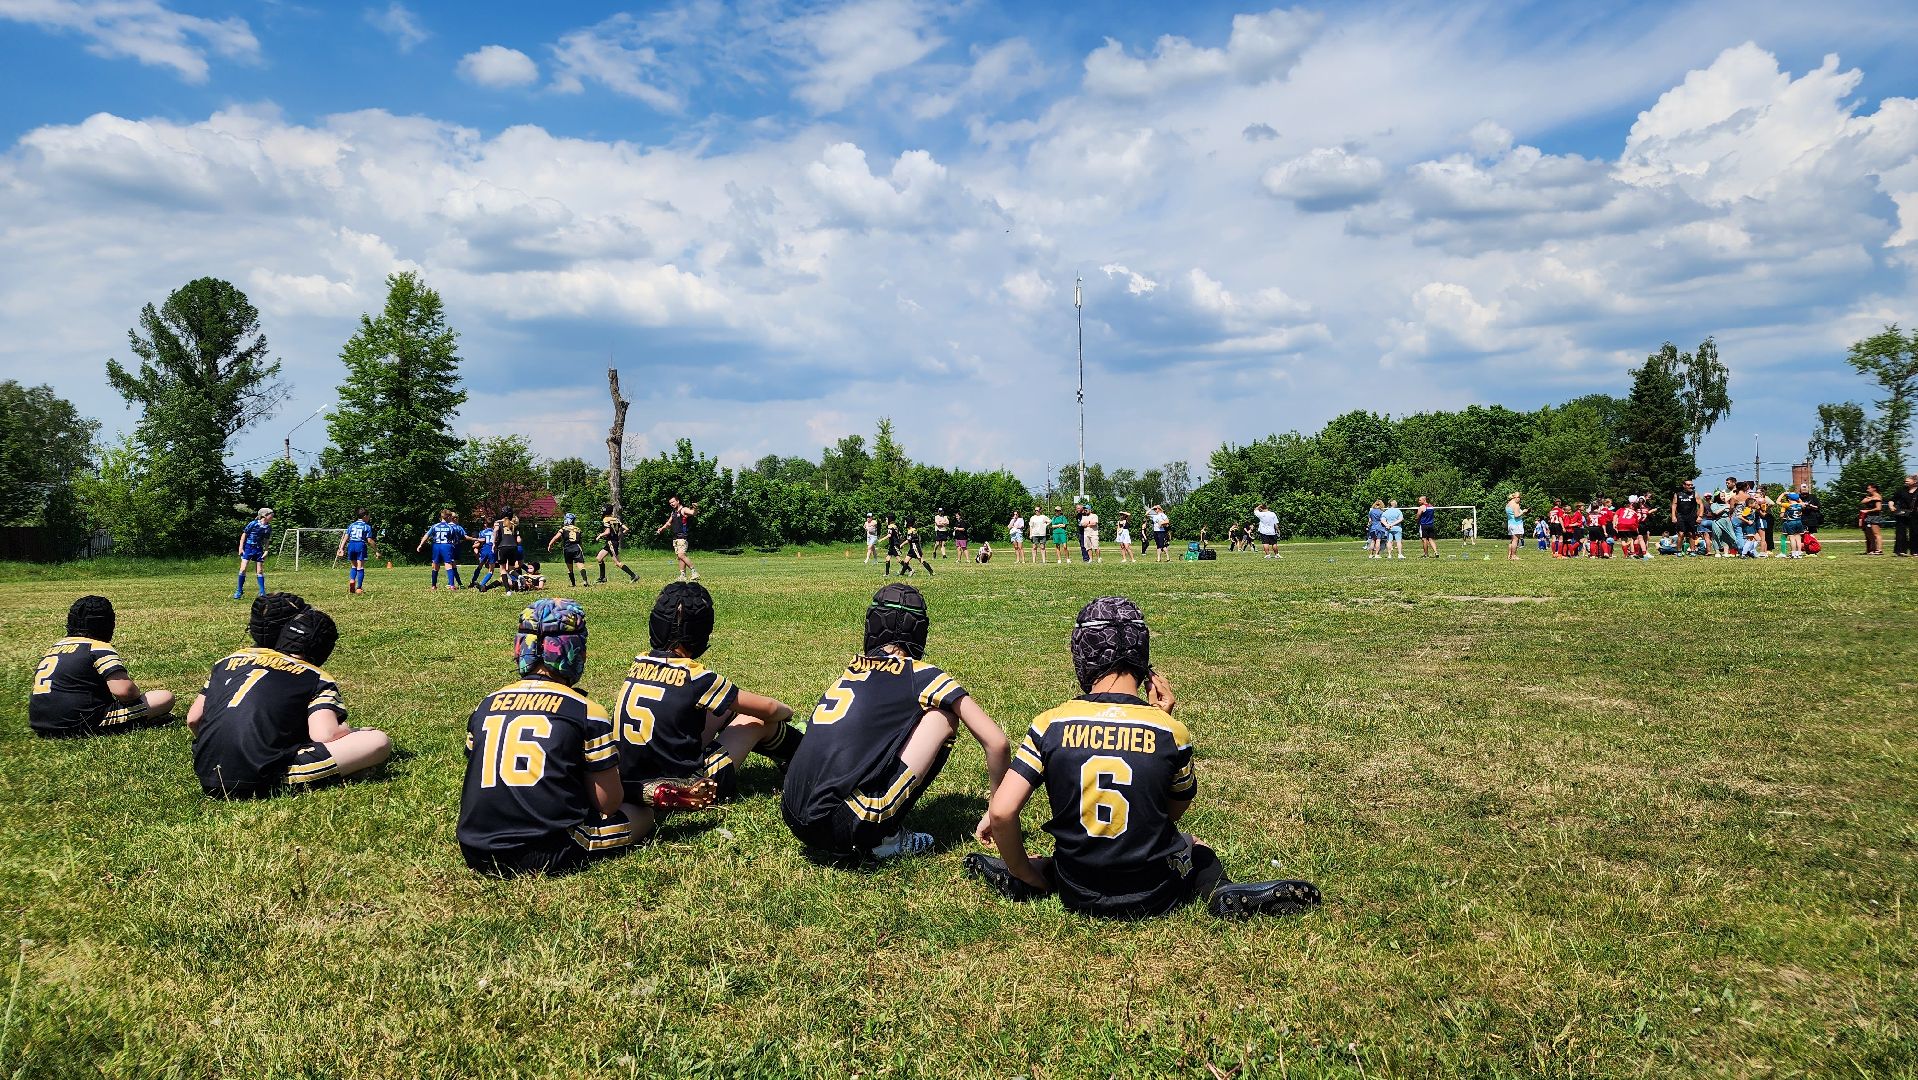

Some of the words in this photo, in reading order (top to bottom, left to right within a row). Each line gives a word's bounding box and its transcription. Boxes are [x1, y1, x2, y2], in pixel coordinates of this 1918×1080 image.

[33, 655, 59, 695] 2
[489, 693, 564, 714] БЕЛКИН
[812, 668, 872, 725] 5
[612, 681, 666, 746] 15
[1061, 724, 1156, 754] КИСЕЛЕВ
[481, 714, 553, 788] 16
[1080, 754, 1133, 840] 6
